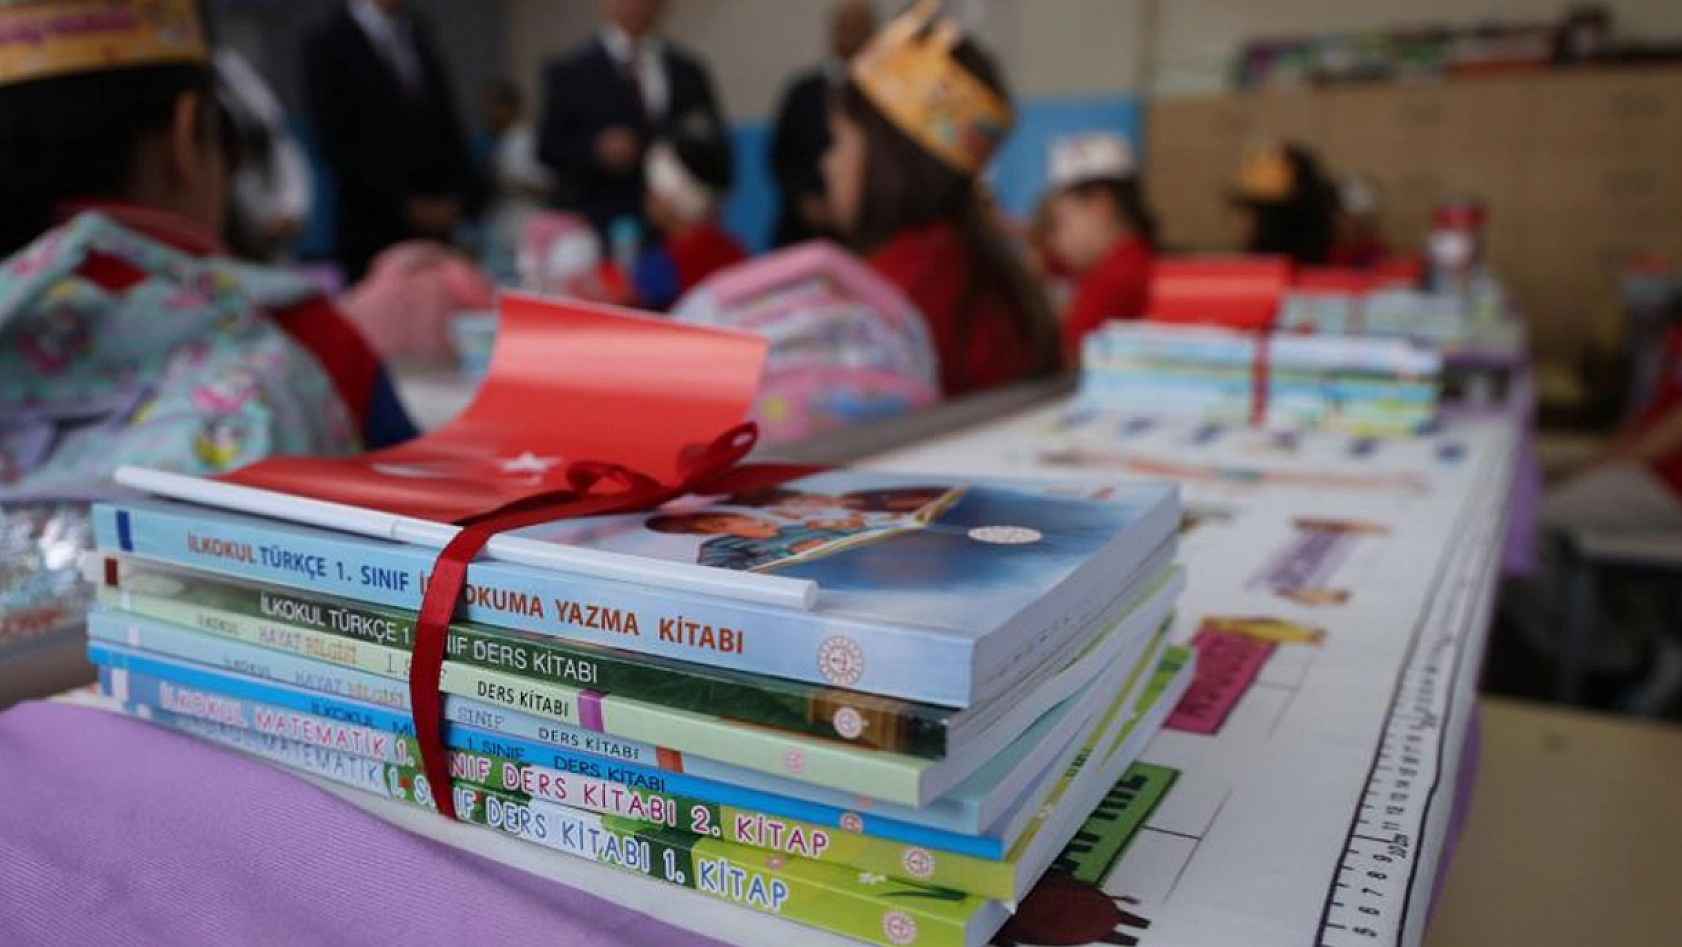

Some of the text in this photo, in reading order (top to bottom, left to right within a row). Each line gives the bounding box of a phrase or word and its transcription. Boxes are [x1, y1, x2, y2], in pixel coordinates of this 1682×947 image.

[187, 530, 255, 564] İLKOKUL
[259, 545, 328, 580] TÜRKÇE
[336, 562, 352, 582] 1.
[361, 565, 410, 593] SINIF
[465, 583, 544, 619] OKUMA
[555, 599, 641, 636] YAZMA
[659, 615, 745, 654] KİTABI
[259, 592, 326, 628] İLKOKUL
[327, 607, 397, 644] TÜRKÇE
[473, 640, 528, 669] DERS
[532, 649, 598, 684] KİTABI
[456, 706, 506, 730] SINIF
[538, 727, 580, 748] DERS
[585, 736, 640, 760] KİTABI
[477, 680, 514, 706] DERS
[519, 689, 570, 718] KİTABI
[254, 705, 388, 760] MATEMATİK
[502, 762, 569, 800] DERS
[582, 782, 677, 829] KİTABI
[690, 805, 721, 836] 2.
[735, 814, 830, 857] KİTAP
[481, 740, 527, 761] SINIF
[553, 755, 602, 778] DERS
[606, 765, 666, 792] KİTABI
[484, 794, 549, 840] DERS
[559, 820, 651, 873] KİTABI
[661, 847, 686, 884] 1.
[698, 859, 789, 911] KİTAP
[1361, 888, 1384, 897] 7
